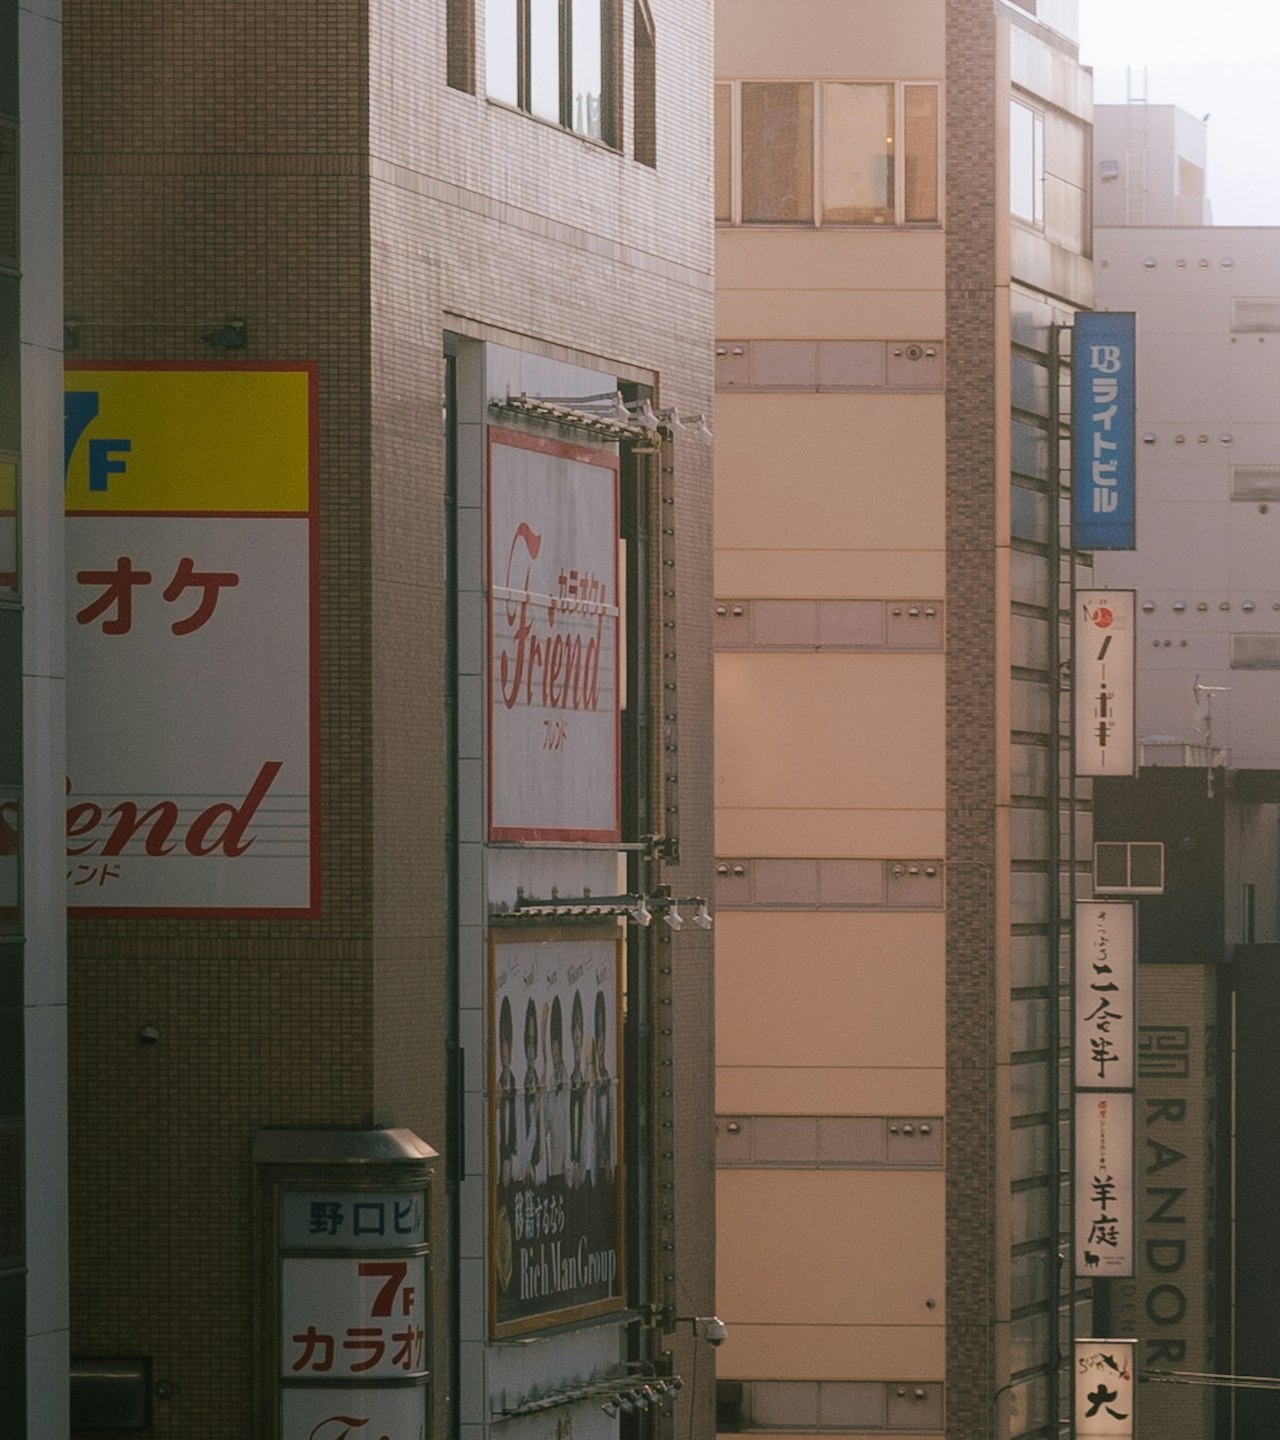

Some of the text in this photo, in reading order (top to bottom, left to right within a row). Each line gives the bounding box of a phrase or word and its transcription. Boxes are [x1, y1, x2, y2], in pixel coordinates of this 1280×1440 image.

[500, 521, 601, 710] Friend
[65, 762, 284, 858] end
[1088, 1175, 1119, 1247] 羊庭
[521, 1236, 616, 1300] Rich Man Group
